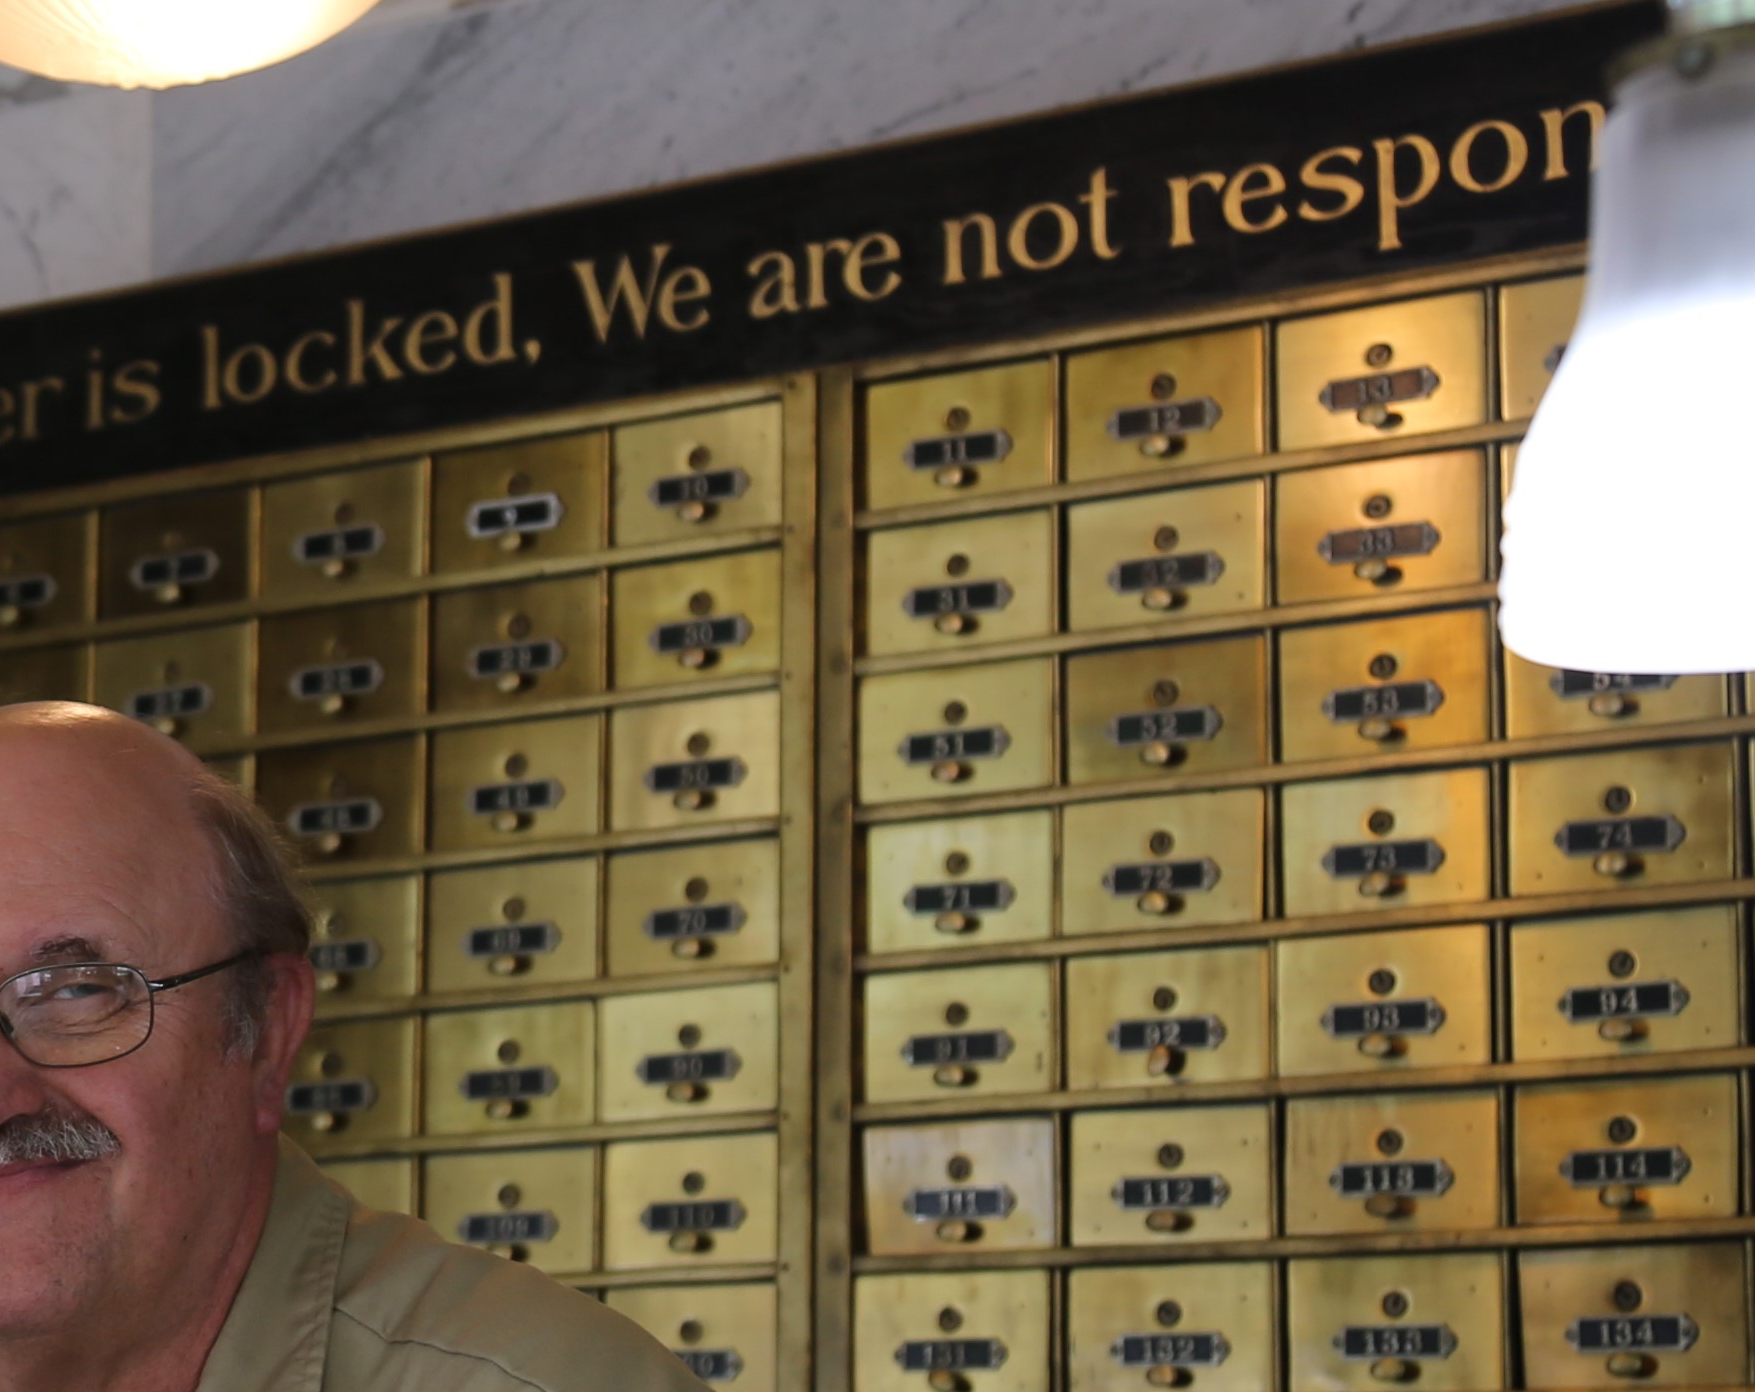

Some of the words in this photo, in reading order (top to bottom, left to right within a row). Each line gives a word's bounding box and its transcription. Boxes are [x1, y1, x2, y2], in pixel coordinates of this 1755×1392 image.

[86, 347, 161, 430] is
[571, 243, 712, 343] We
[746, 229, 902, 319] are
[941, 166, 1122, 286] not
[1357, 376, 1392, 400] 13
[1149, 407, 1181, 432] 12
[944, 437, 966, 462] 11
[1359, 527, 1395, 554] 33
[940, 587, 968, 612] 31
[1362, 687, 1398, 715] 53
[1142, 712, 1177, 738] 52
[933, 733, 965, 759] 51
[1596, 823, 1633, 849] 74
[1362, 847, 1396, 871] 73
[1138, 865, 1173, 890] 72
[942, 886, 970, 909] 71
[1599, 987, 1637, 1013] 94
[1363, 1007, 1399, 1031] 93
[1145, 1022, 1181, 1046] 92
[936, 1036, 968, 1059] 91
[1362, 1167, 1414, 1191] 113
[1596, 1155, 1646, 1179] 114
[941, 1193, 977, 1215] 111
[1143, 1181, 1194, 1205] 112
[1365, 1329, 1421, 1354] 133
[1599, 1321, 1653, 1346] 134
[1145, 1338, 1194, 1362] 132
